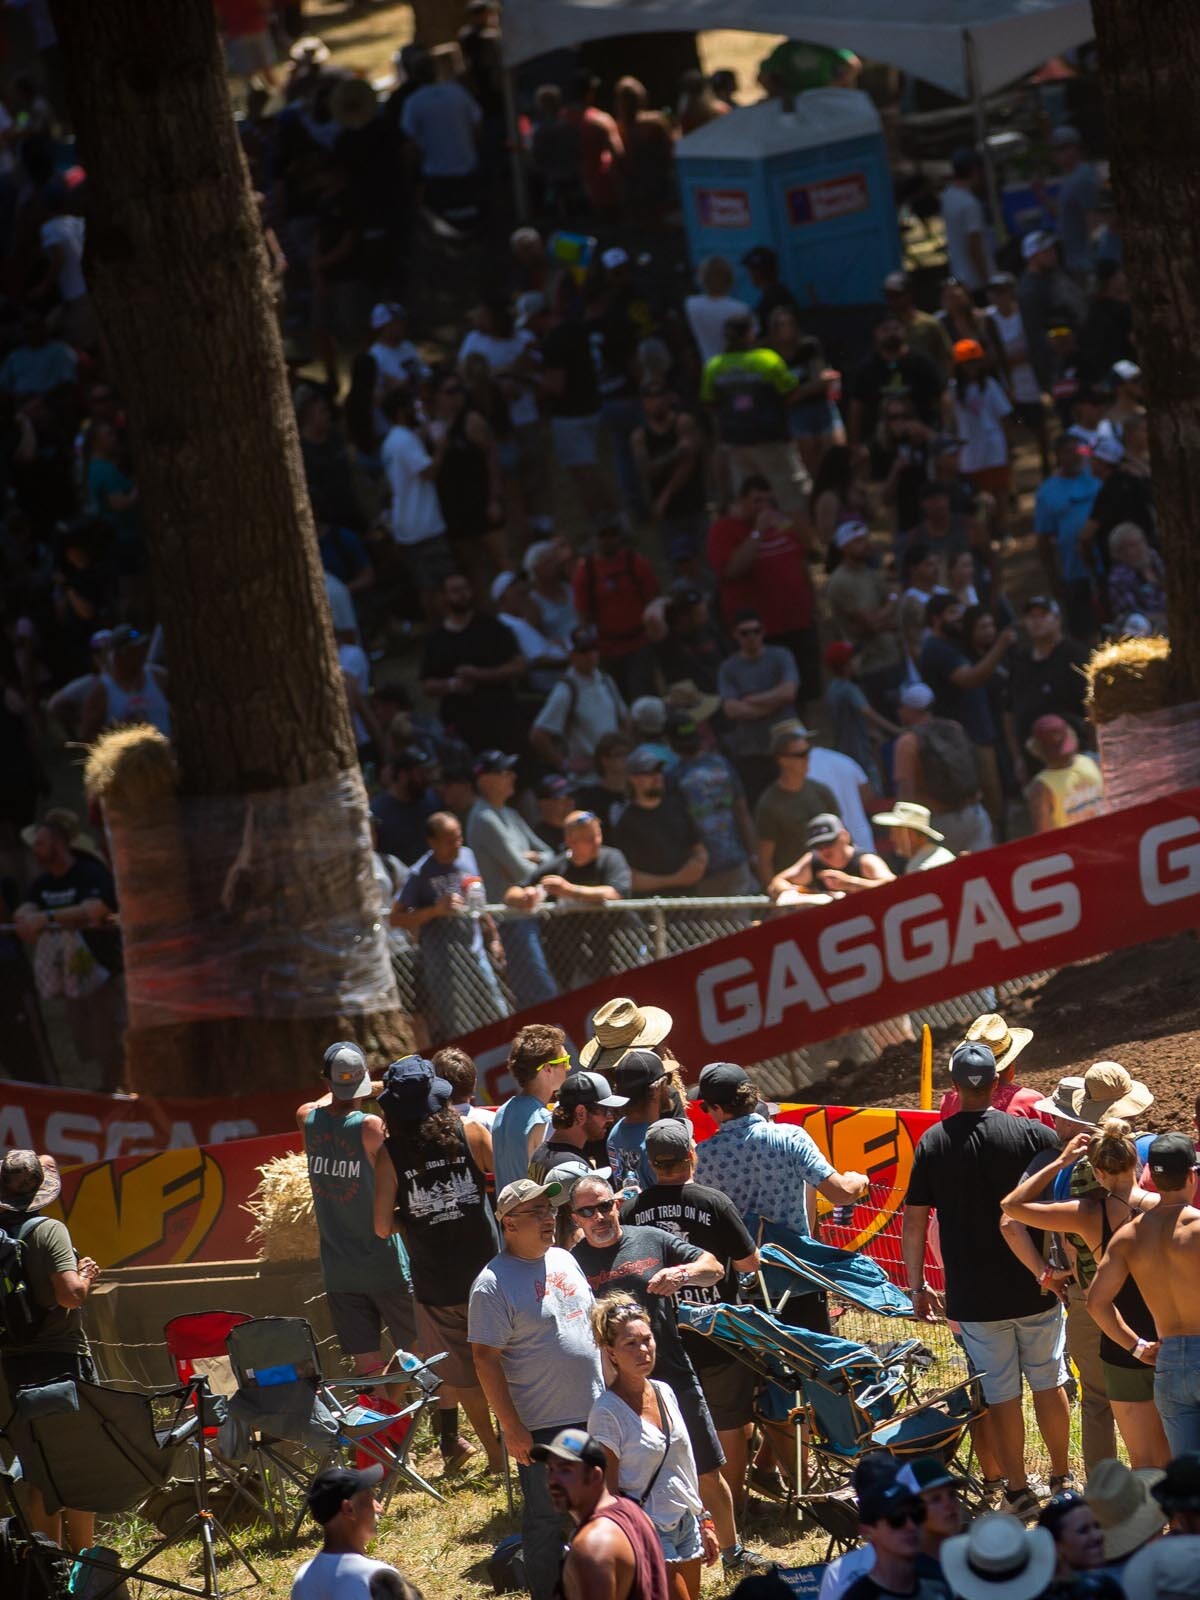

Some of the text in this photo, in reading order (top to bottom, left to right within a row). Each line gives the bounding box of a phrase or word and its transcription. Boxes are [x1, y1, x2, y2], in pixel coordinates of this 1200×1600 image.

[696, 853, 1081, 1046] GASGAS
[404, 1159, 446, 1180] RAROAD
[635, 1204, 712, 1226] DONT TREAD ON ME
